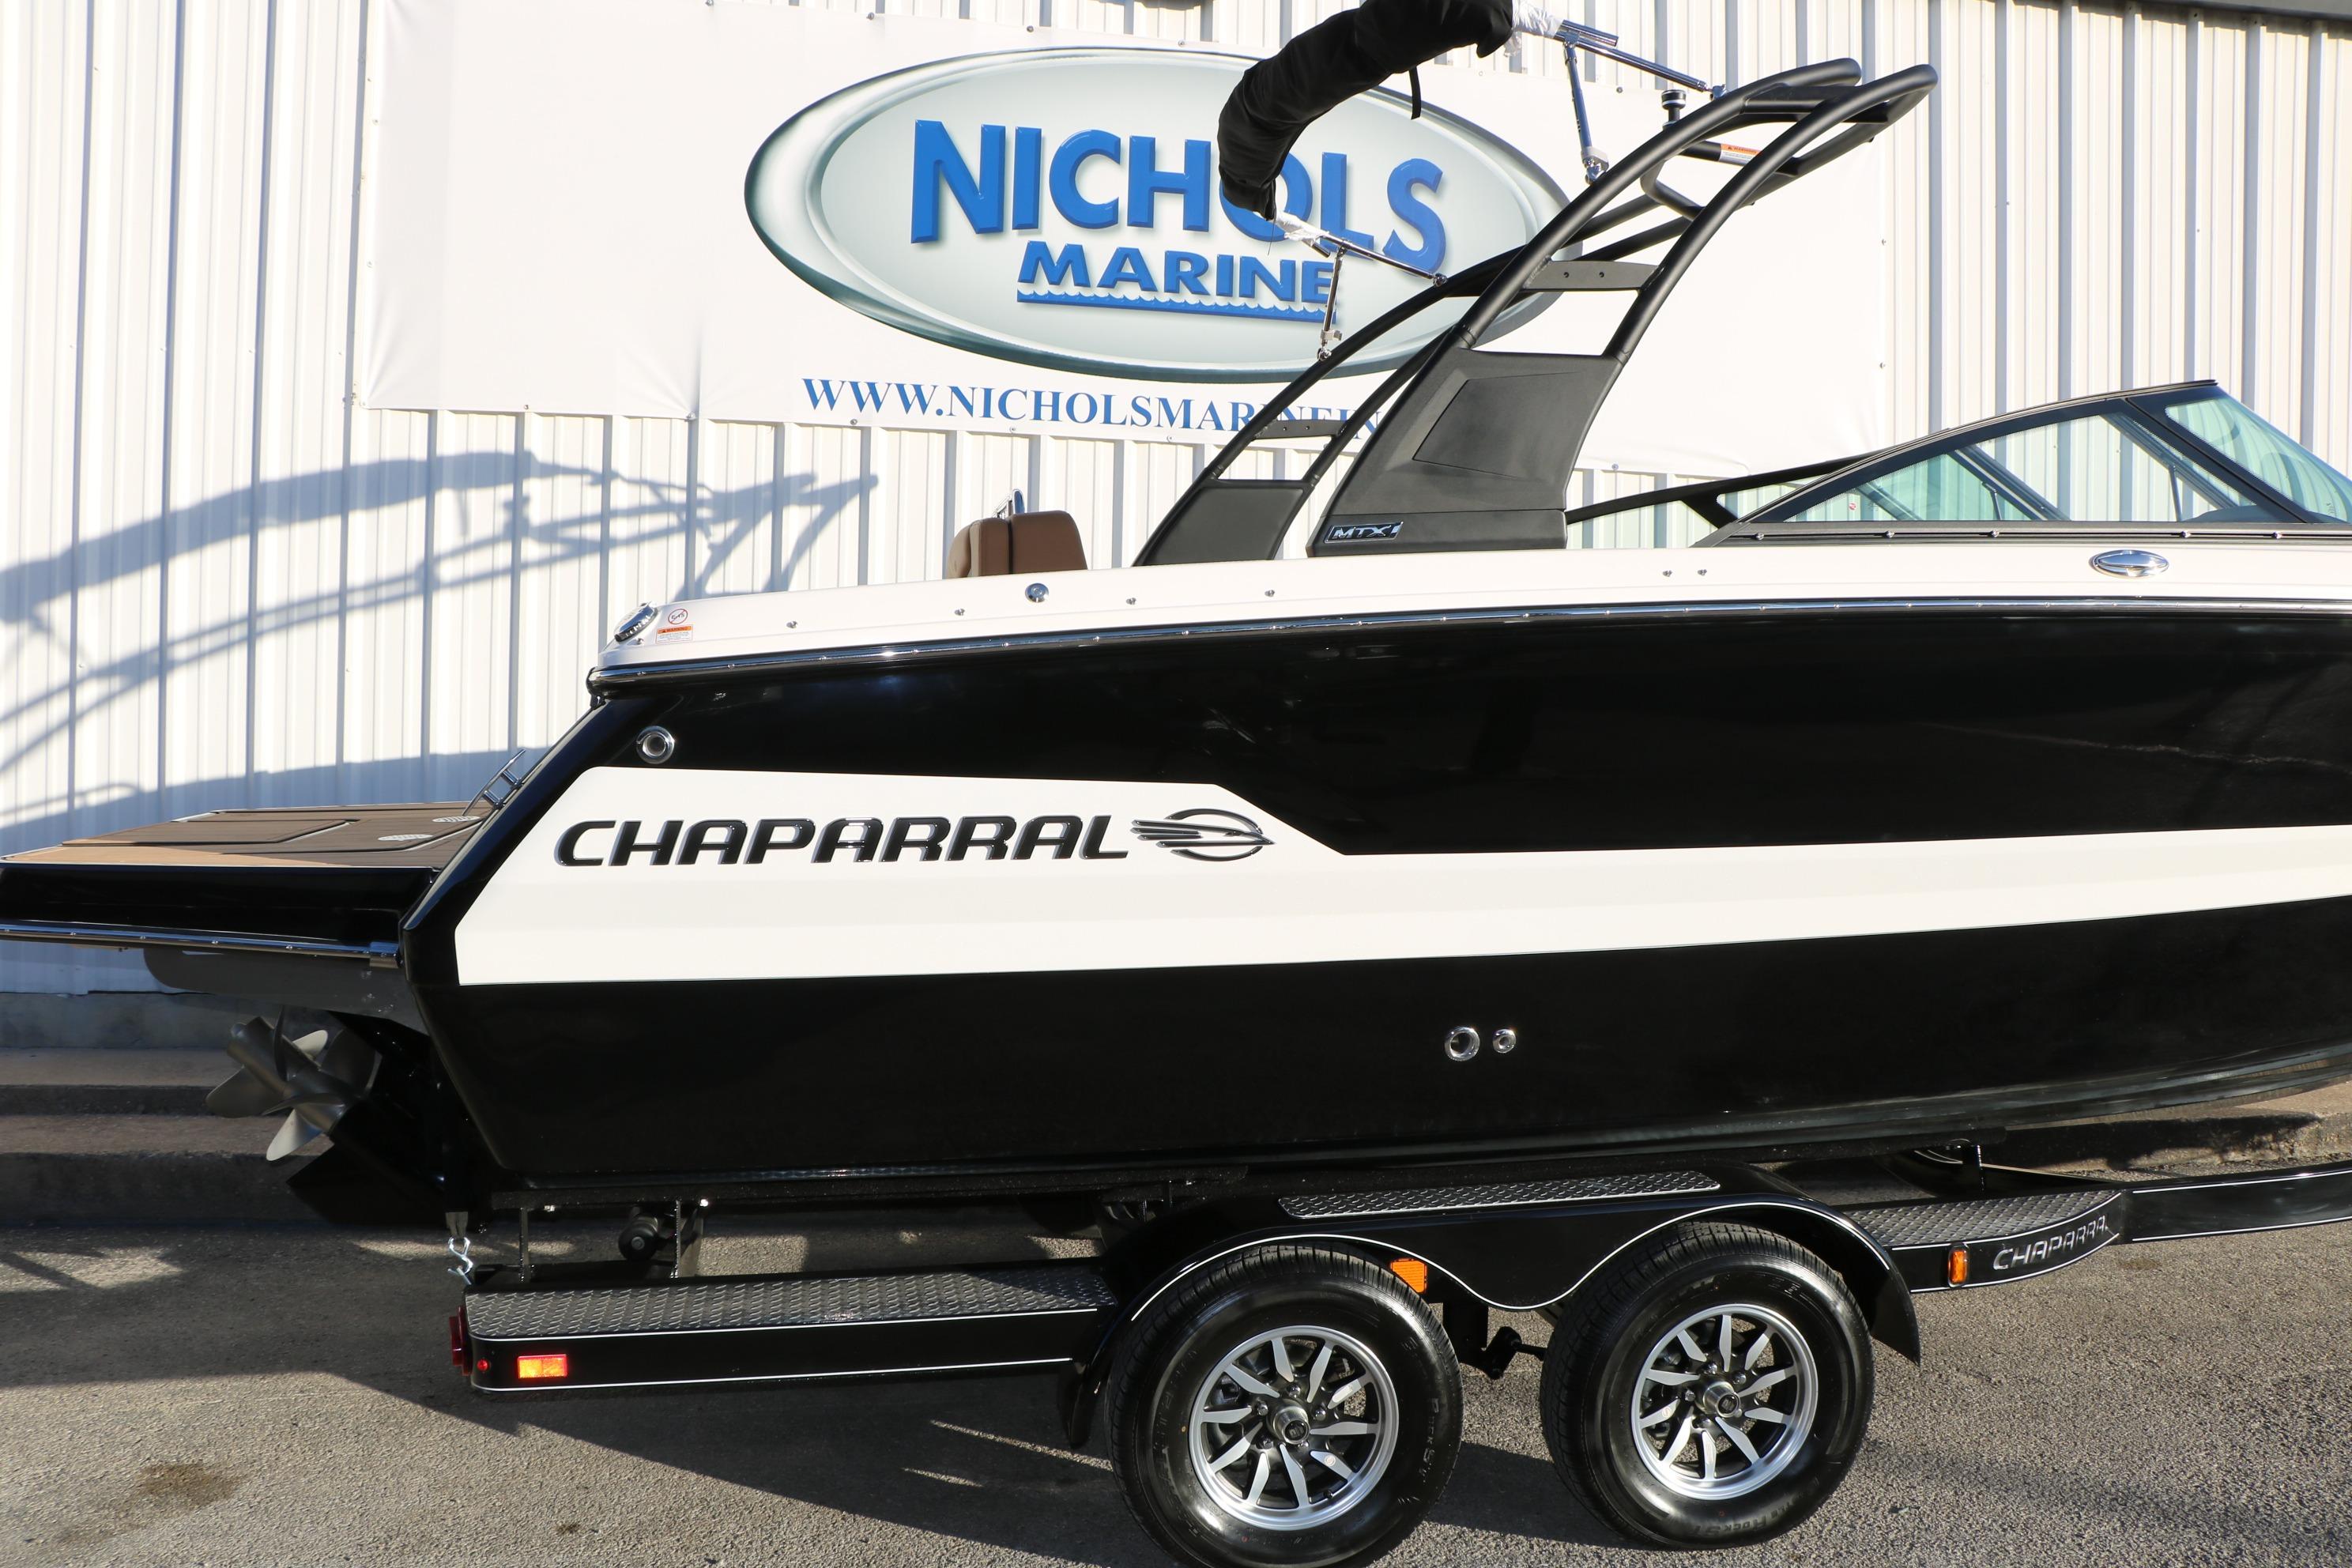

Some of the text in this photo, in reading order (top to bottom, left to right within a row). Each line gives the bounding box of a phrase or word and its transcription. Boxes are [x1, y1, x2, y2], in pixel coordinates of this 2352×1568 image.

[910, 119, 1447, 277] NICHOLS
[1018, 239, 1337, 305] MARINE
[553, 814, 1130, 868] CHAPARRAL
